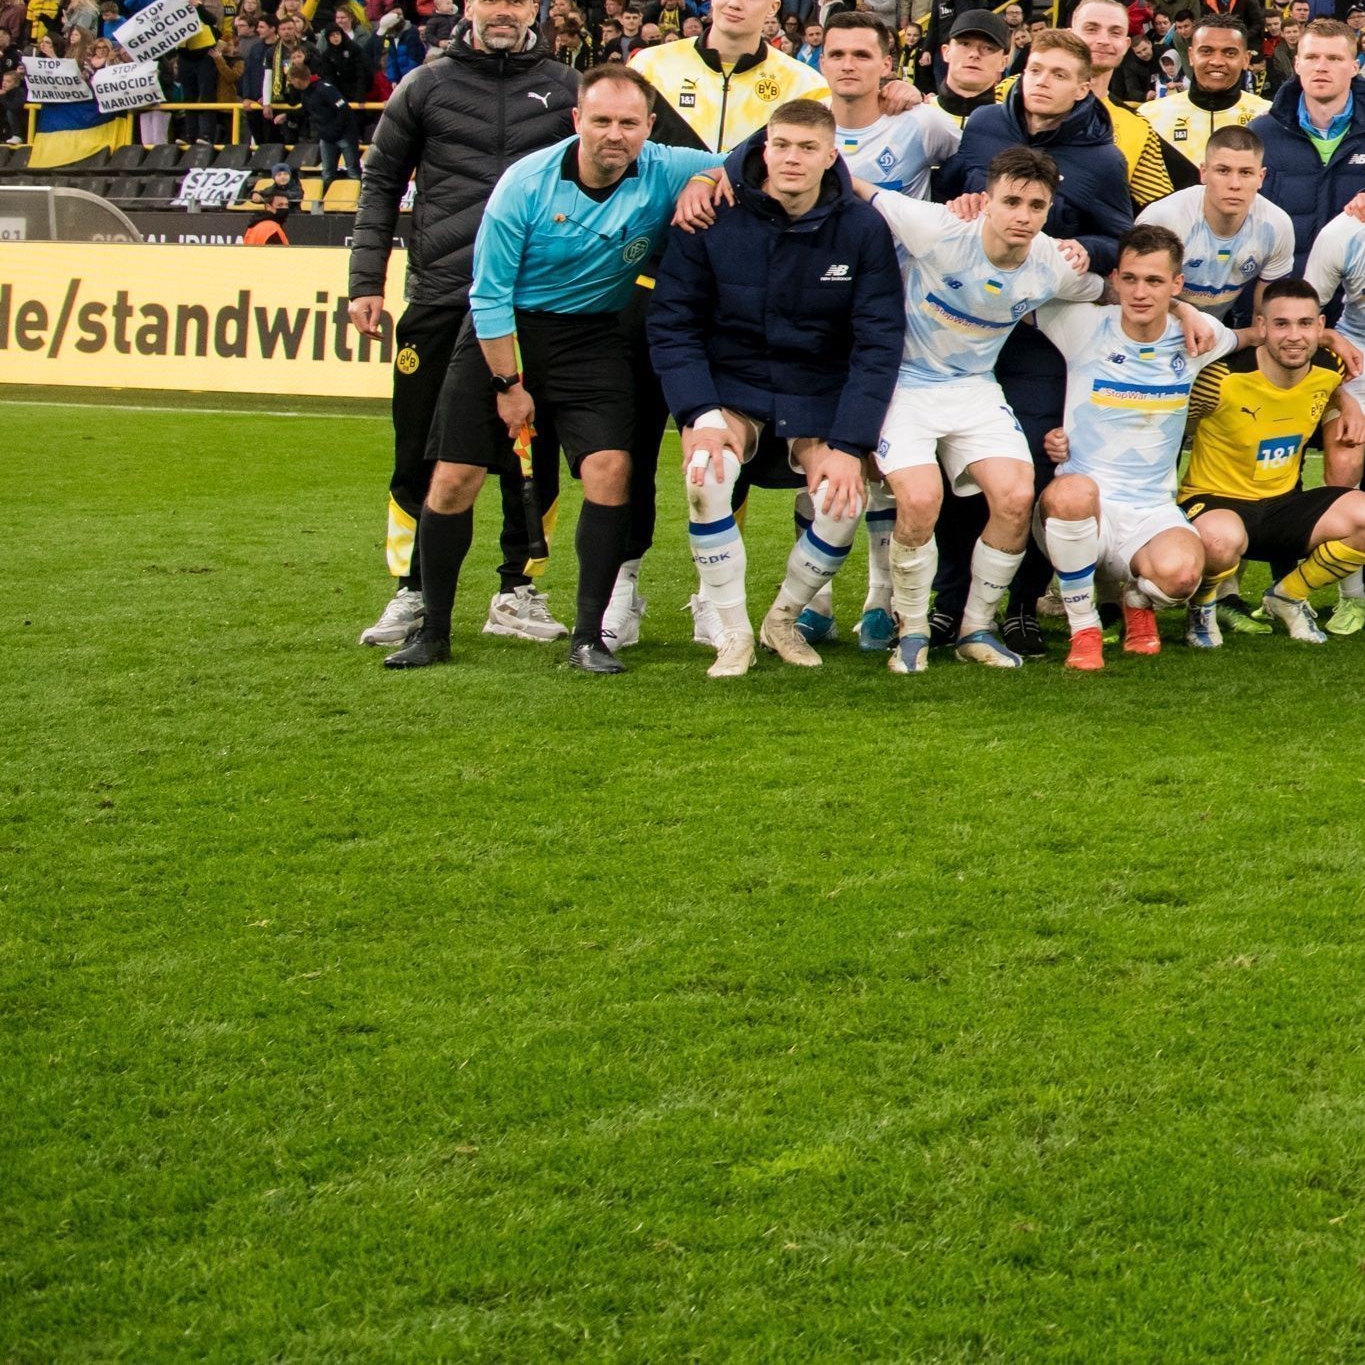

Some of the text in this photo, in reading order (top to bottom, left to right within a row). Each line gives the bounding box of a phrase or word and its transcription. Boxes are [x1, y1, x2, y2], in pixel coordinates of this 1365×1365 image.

[136, 2, 164, 25] STOP
[128, 4, 195, 49] GENOCIDE
[38, 60, 61, 69] STOP
[112, 64, 137, 75] STOP
[28, 75, 81, 85] GENOCIDE
[96, 76, 155, 94] GENOCIDE
[759, 81, 778, 96] BVB
[31, 89, 89, 100] MARIUPOL
[101, 91, 161, 111] MARIUPOL
[681, 95, 695, 105] 1&1
[187, 172, 245, 190] STOP
[400, 350, 417, 368] BVB
[1261, 446, 1297, 471] 1&1
